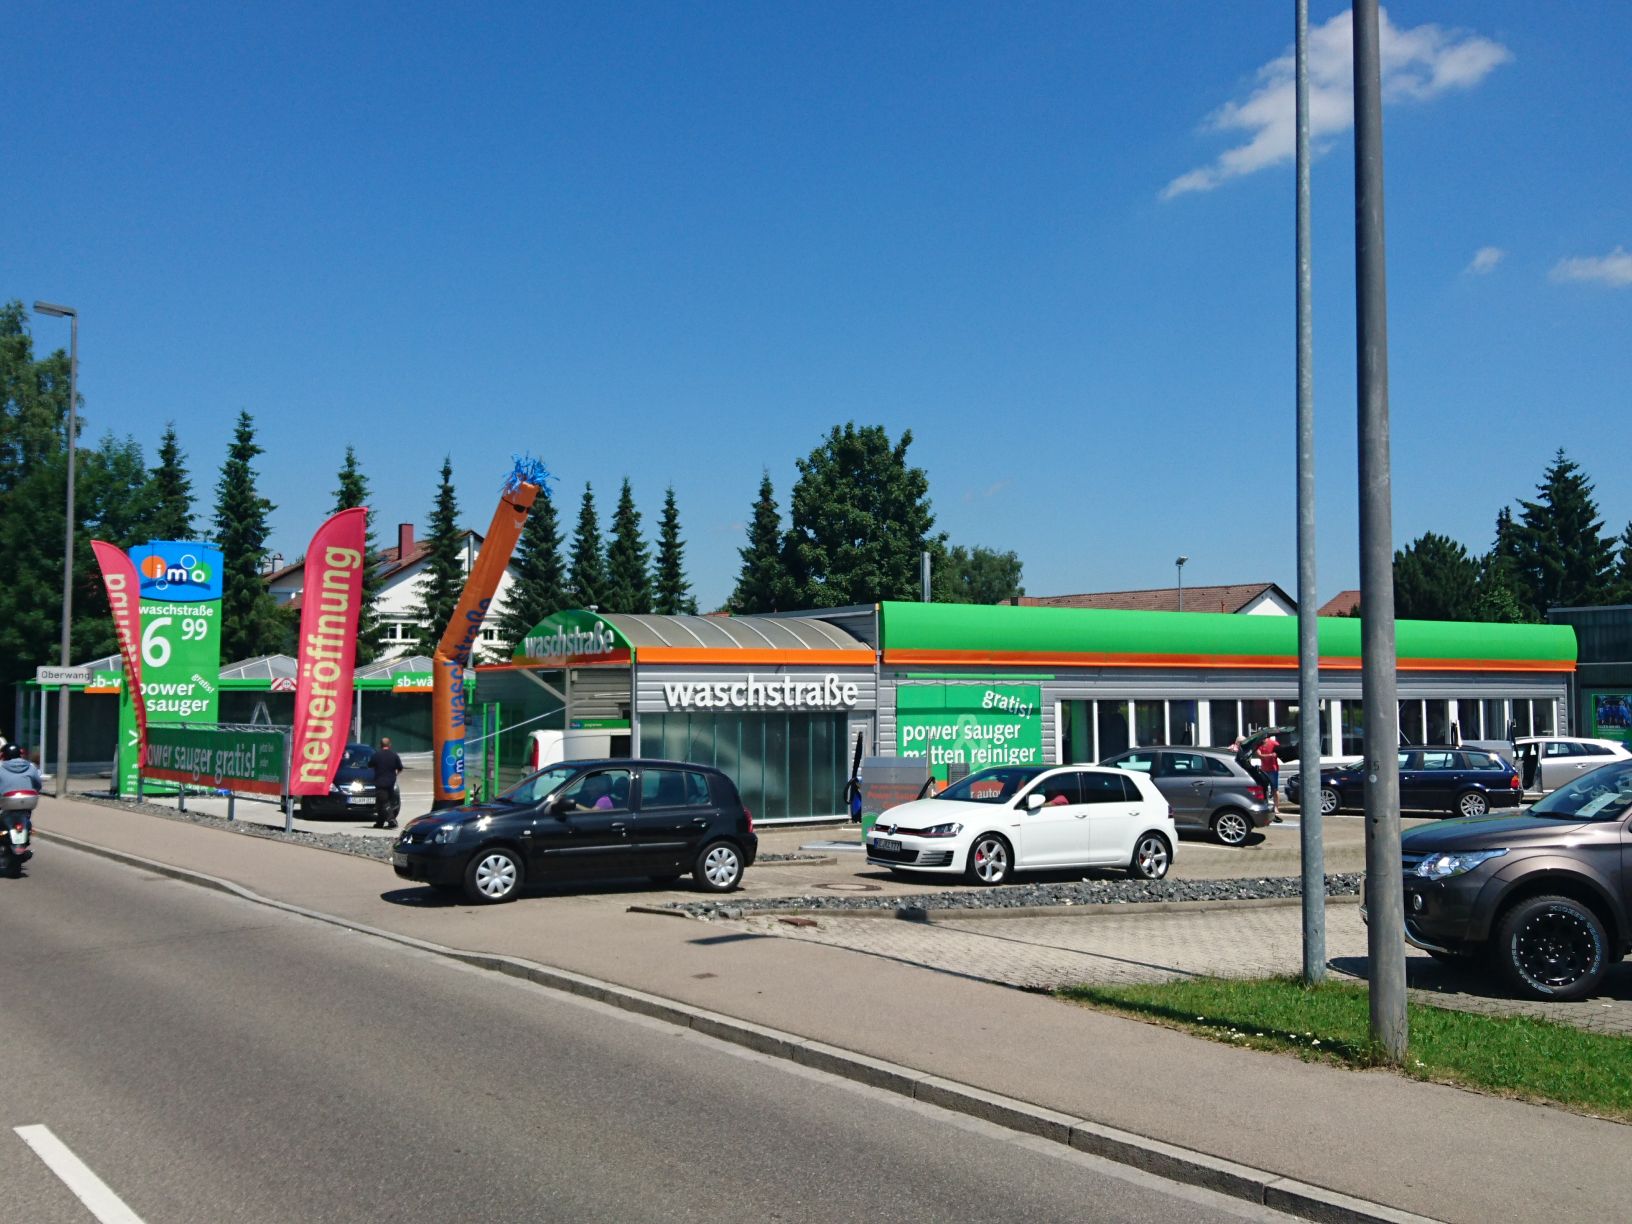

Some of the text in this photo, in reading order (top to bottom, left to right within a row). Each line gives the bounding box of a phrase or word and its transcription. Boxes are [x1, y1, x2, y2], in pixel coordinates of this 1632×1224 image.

[156, 564, 205, 583] imo
[138, 604, 214, 617] waschstraße
[141, 617, 208, 668] 6 99
[525, 621, 615, 658] waschstraße
[300, 546, 362, 783] neueröffnung
[191, 673, 215, 694] gratis!
[664, 673, 859, 707] waschstraße
[146, 699, 210, 717] sauger
[981, 690, 1034, 720] gratis!
[903, 723, 1021, 747] power sauger
[147, 743, 173, 768] ower
[174, 745, 213, 781] sauger
[214, 743, 256, 785] gratis!
[971, 743, 1037, 765] reiniger
